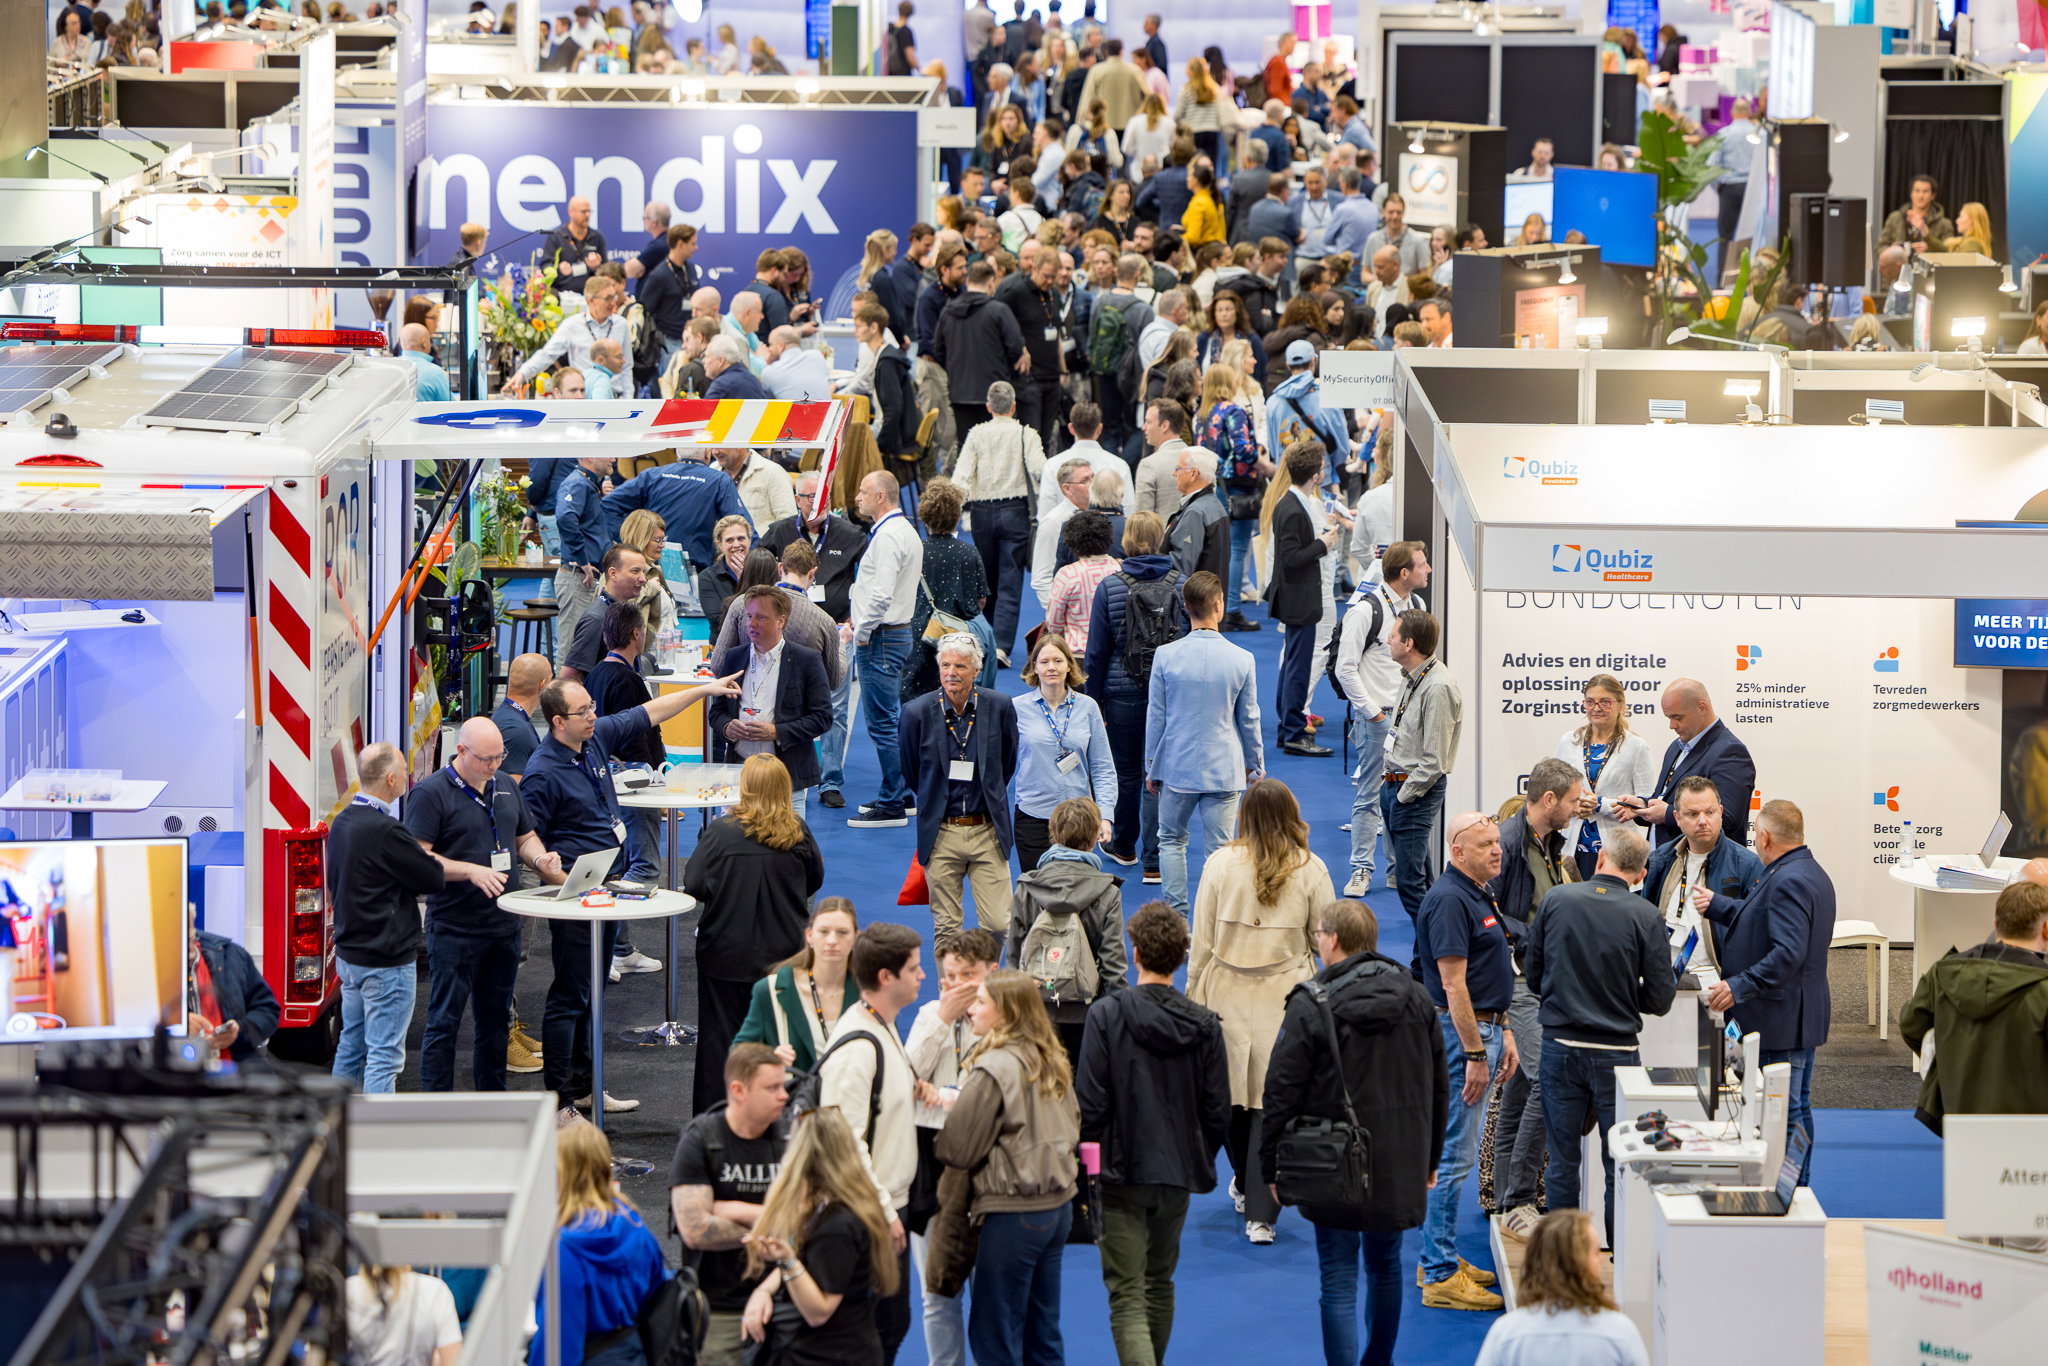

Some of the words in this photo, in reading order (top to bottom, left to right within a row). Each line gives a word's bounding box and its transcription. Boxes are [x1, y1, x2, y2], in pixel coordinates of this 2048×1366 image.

[1528, 460, 1579, 478] Qubiz
[1586, 549, 1653, 572] Qubiz
[1974, 615, 2023, 629] MEER
[1973, 635, 2022, 649] VOOR
[1502, 652, 1564, 668] Advies
[1569, 657, 1591, 668] en
[1596, 653, 1667, 671] digitale
[1620, 680, 1661, 691] voor
[1736, 683, 1762, 693] 25%
[1764, 683, 1806, 693] minder
[1873, 684, 1927, 695] Tevreden
[1735, 698, 1830, 709] administratieve
[1873, 701, 1980, 712] zorgmedewerkers
[1735, 713, 1773, 724] lasten
[1873, 823, 1901, 834] Bete
[1916, 826, 1943, 837] zorg
[1873, 841, 1900, 849] voor
[1919, 1340, 1972, 1363] Master
